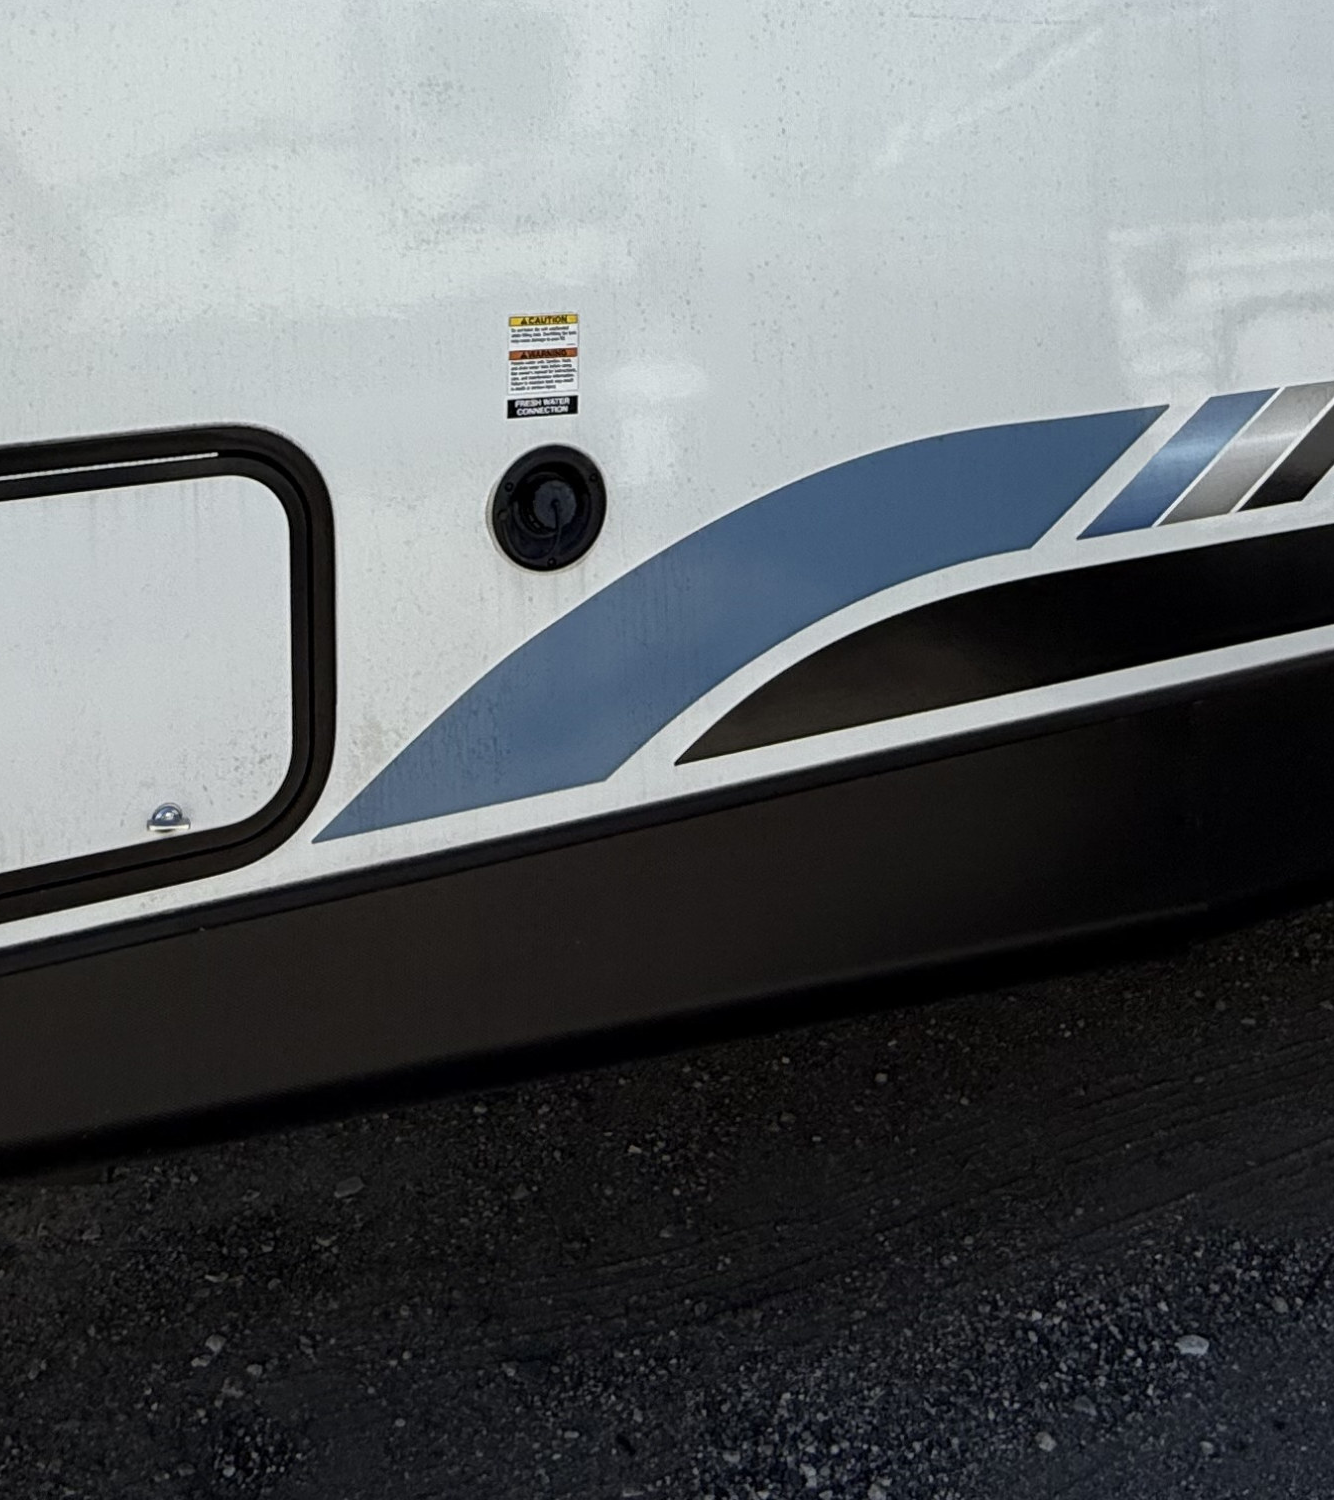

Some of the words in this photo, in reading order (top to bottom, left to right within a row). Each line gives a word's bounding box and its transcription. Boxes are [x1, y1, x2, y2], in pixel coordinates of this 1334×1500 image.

[528, 315, 568, 325] CAUTION
[514, 399, 542, 408] FRESH
[543, 397, 570, 406] WATER
[516, 406, 569, 416] CONNECTION
